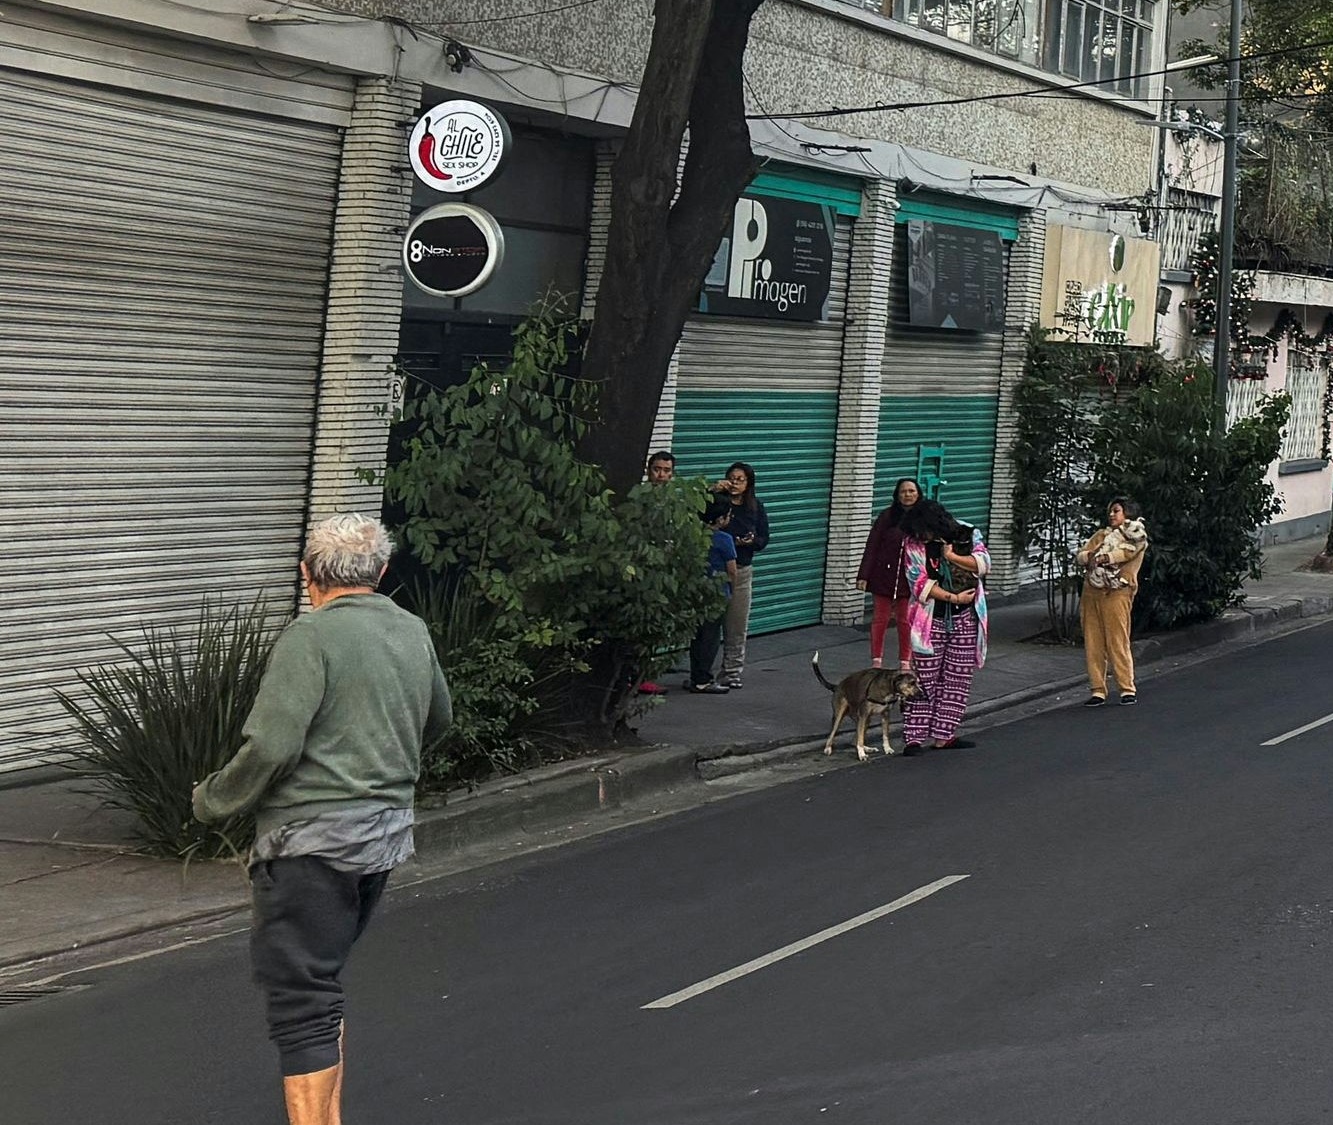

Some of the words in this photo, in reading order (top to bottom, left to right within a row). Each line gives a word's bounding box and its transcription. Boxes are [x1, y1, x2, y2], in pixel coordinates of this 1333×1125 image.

[447, 118, 460, 133] AL
[440, 126, 484, 160] CHILE
[442, 161, 456, 169] SEX
[458, 161, 479, 169] SHOP
